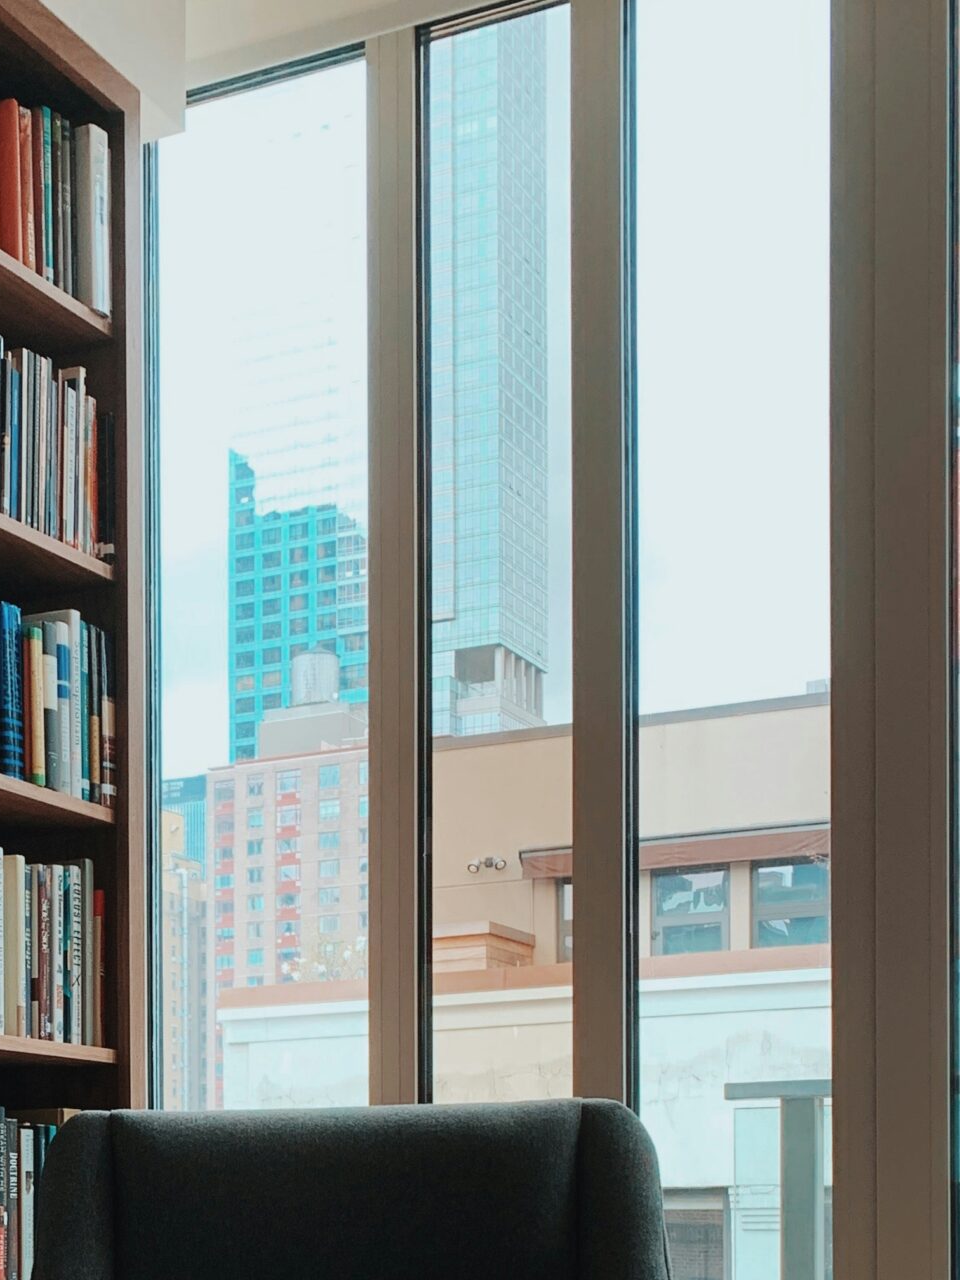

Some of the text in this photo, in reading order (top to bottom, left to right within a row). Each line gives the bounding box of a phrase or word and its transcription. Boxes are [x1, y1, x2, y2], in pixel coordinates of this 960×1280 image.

[73, 882, 81, 967] LOCUST EFFECT
[9, 1152, 18, 1200] DOCTRINE
